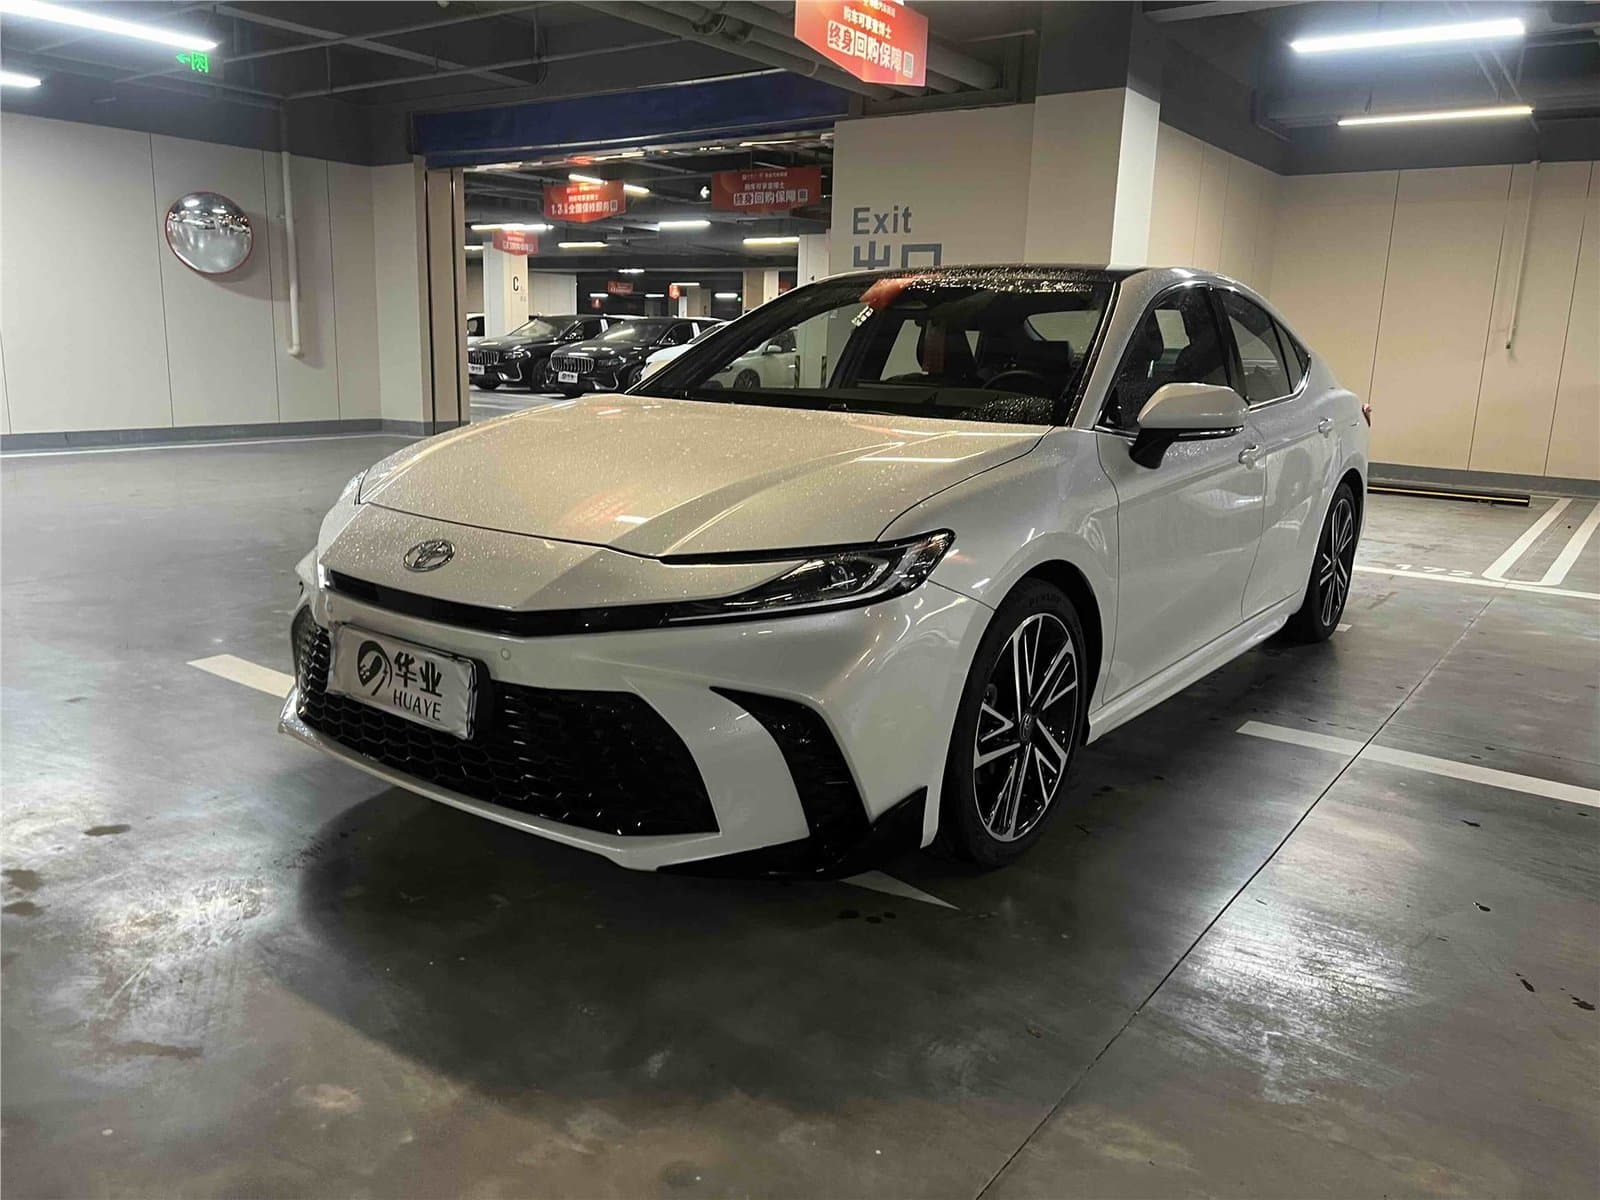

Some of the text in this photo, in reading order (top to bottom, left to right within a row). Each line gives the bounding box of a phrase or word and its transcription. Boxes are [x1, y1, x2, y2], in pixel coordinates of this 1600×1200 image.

[853, 205, 912, 234] Exit
[394, 651, 443, 697] 华业
[393, 689, 442, 721] HUAYE
